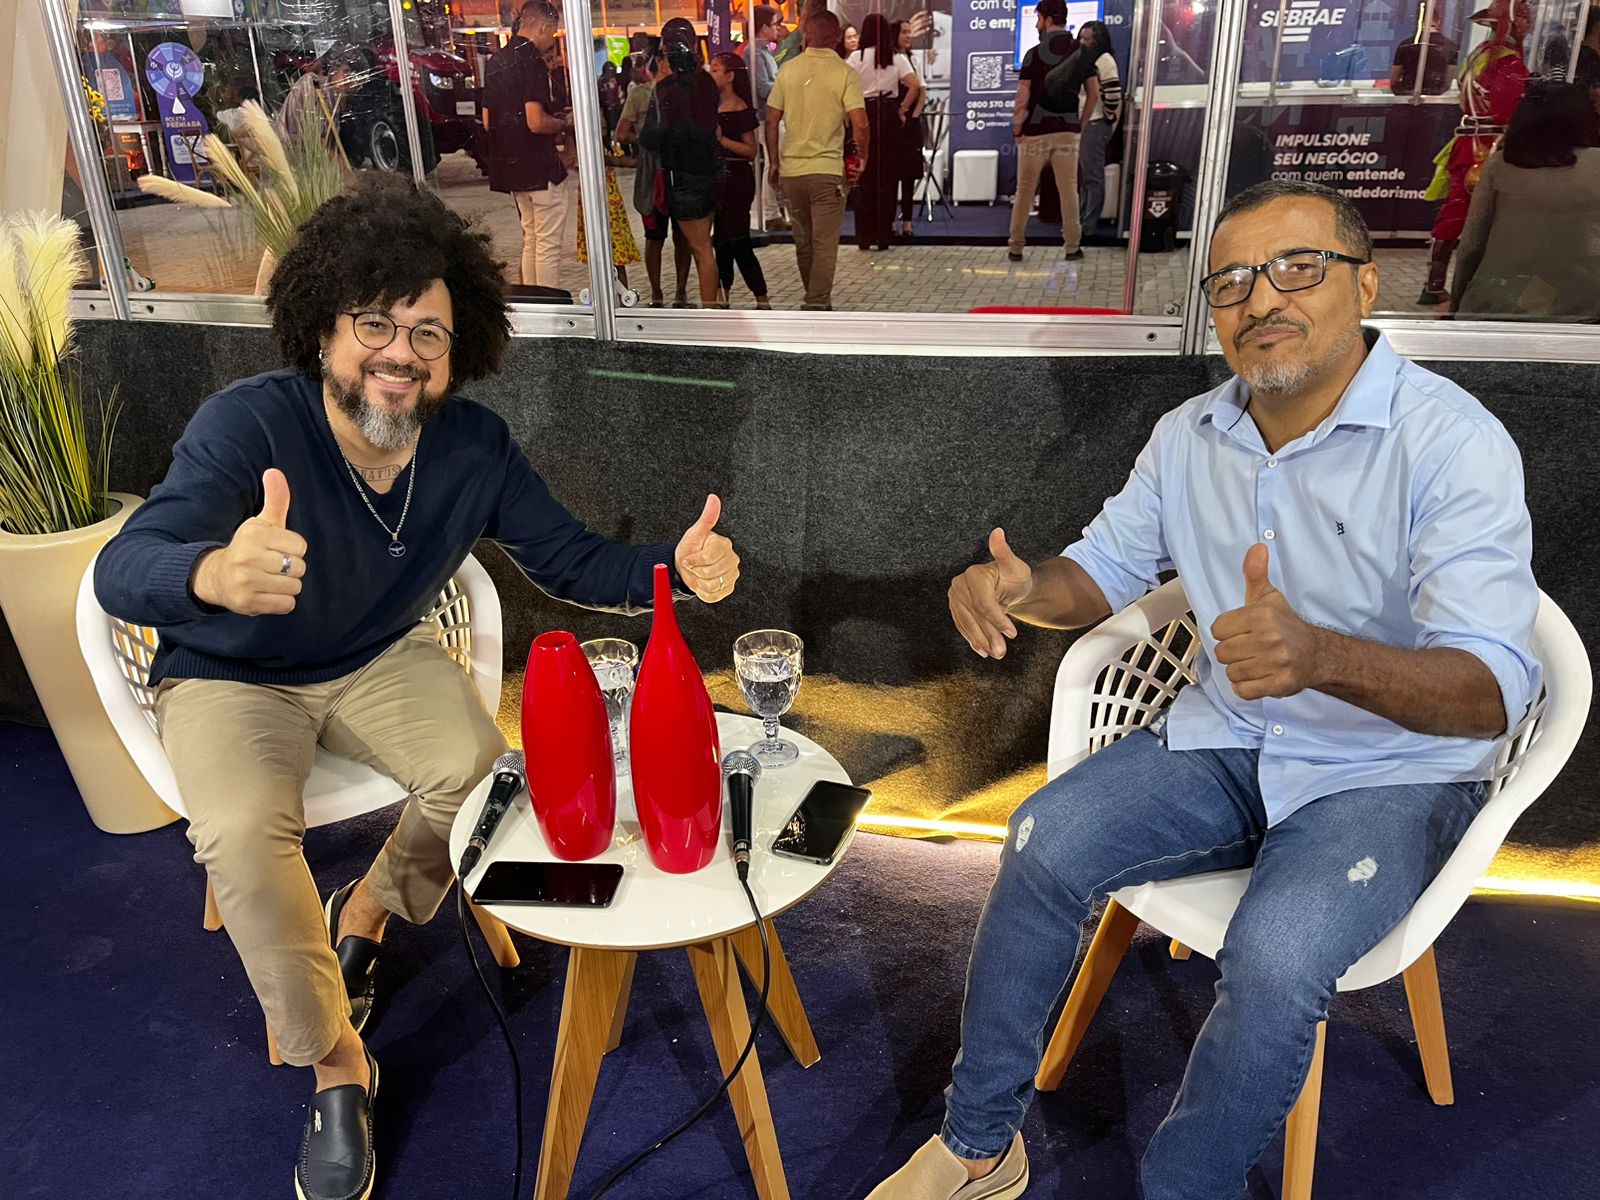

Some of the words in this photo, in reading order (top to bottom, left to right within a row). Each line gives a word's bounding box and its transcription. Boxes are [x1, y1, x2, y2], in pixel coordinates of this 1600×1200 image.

[970, 0, 999, 11] com
[969, 17, 986, 30] de
[1259, 8, 1346, 27] SEBRAE
[1275, 133, 1371, 147] IMPULSIONE
[1273, 152, 1304, 166] SEU
[1305, 149, 1378, 165] NEGÓCIO
[1271, 171, 1302, 181] com
[1305, 170, 1344, 182] quem
[1346, 168, 1405, 180] entende
